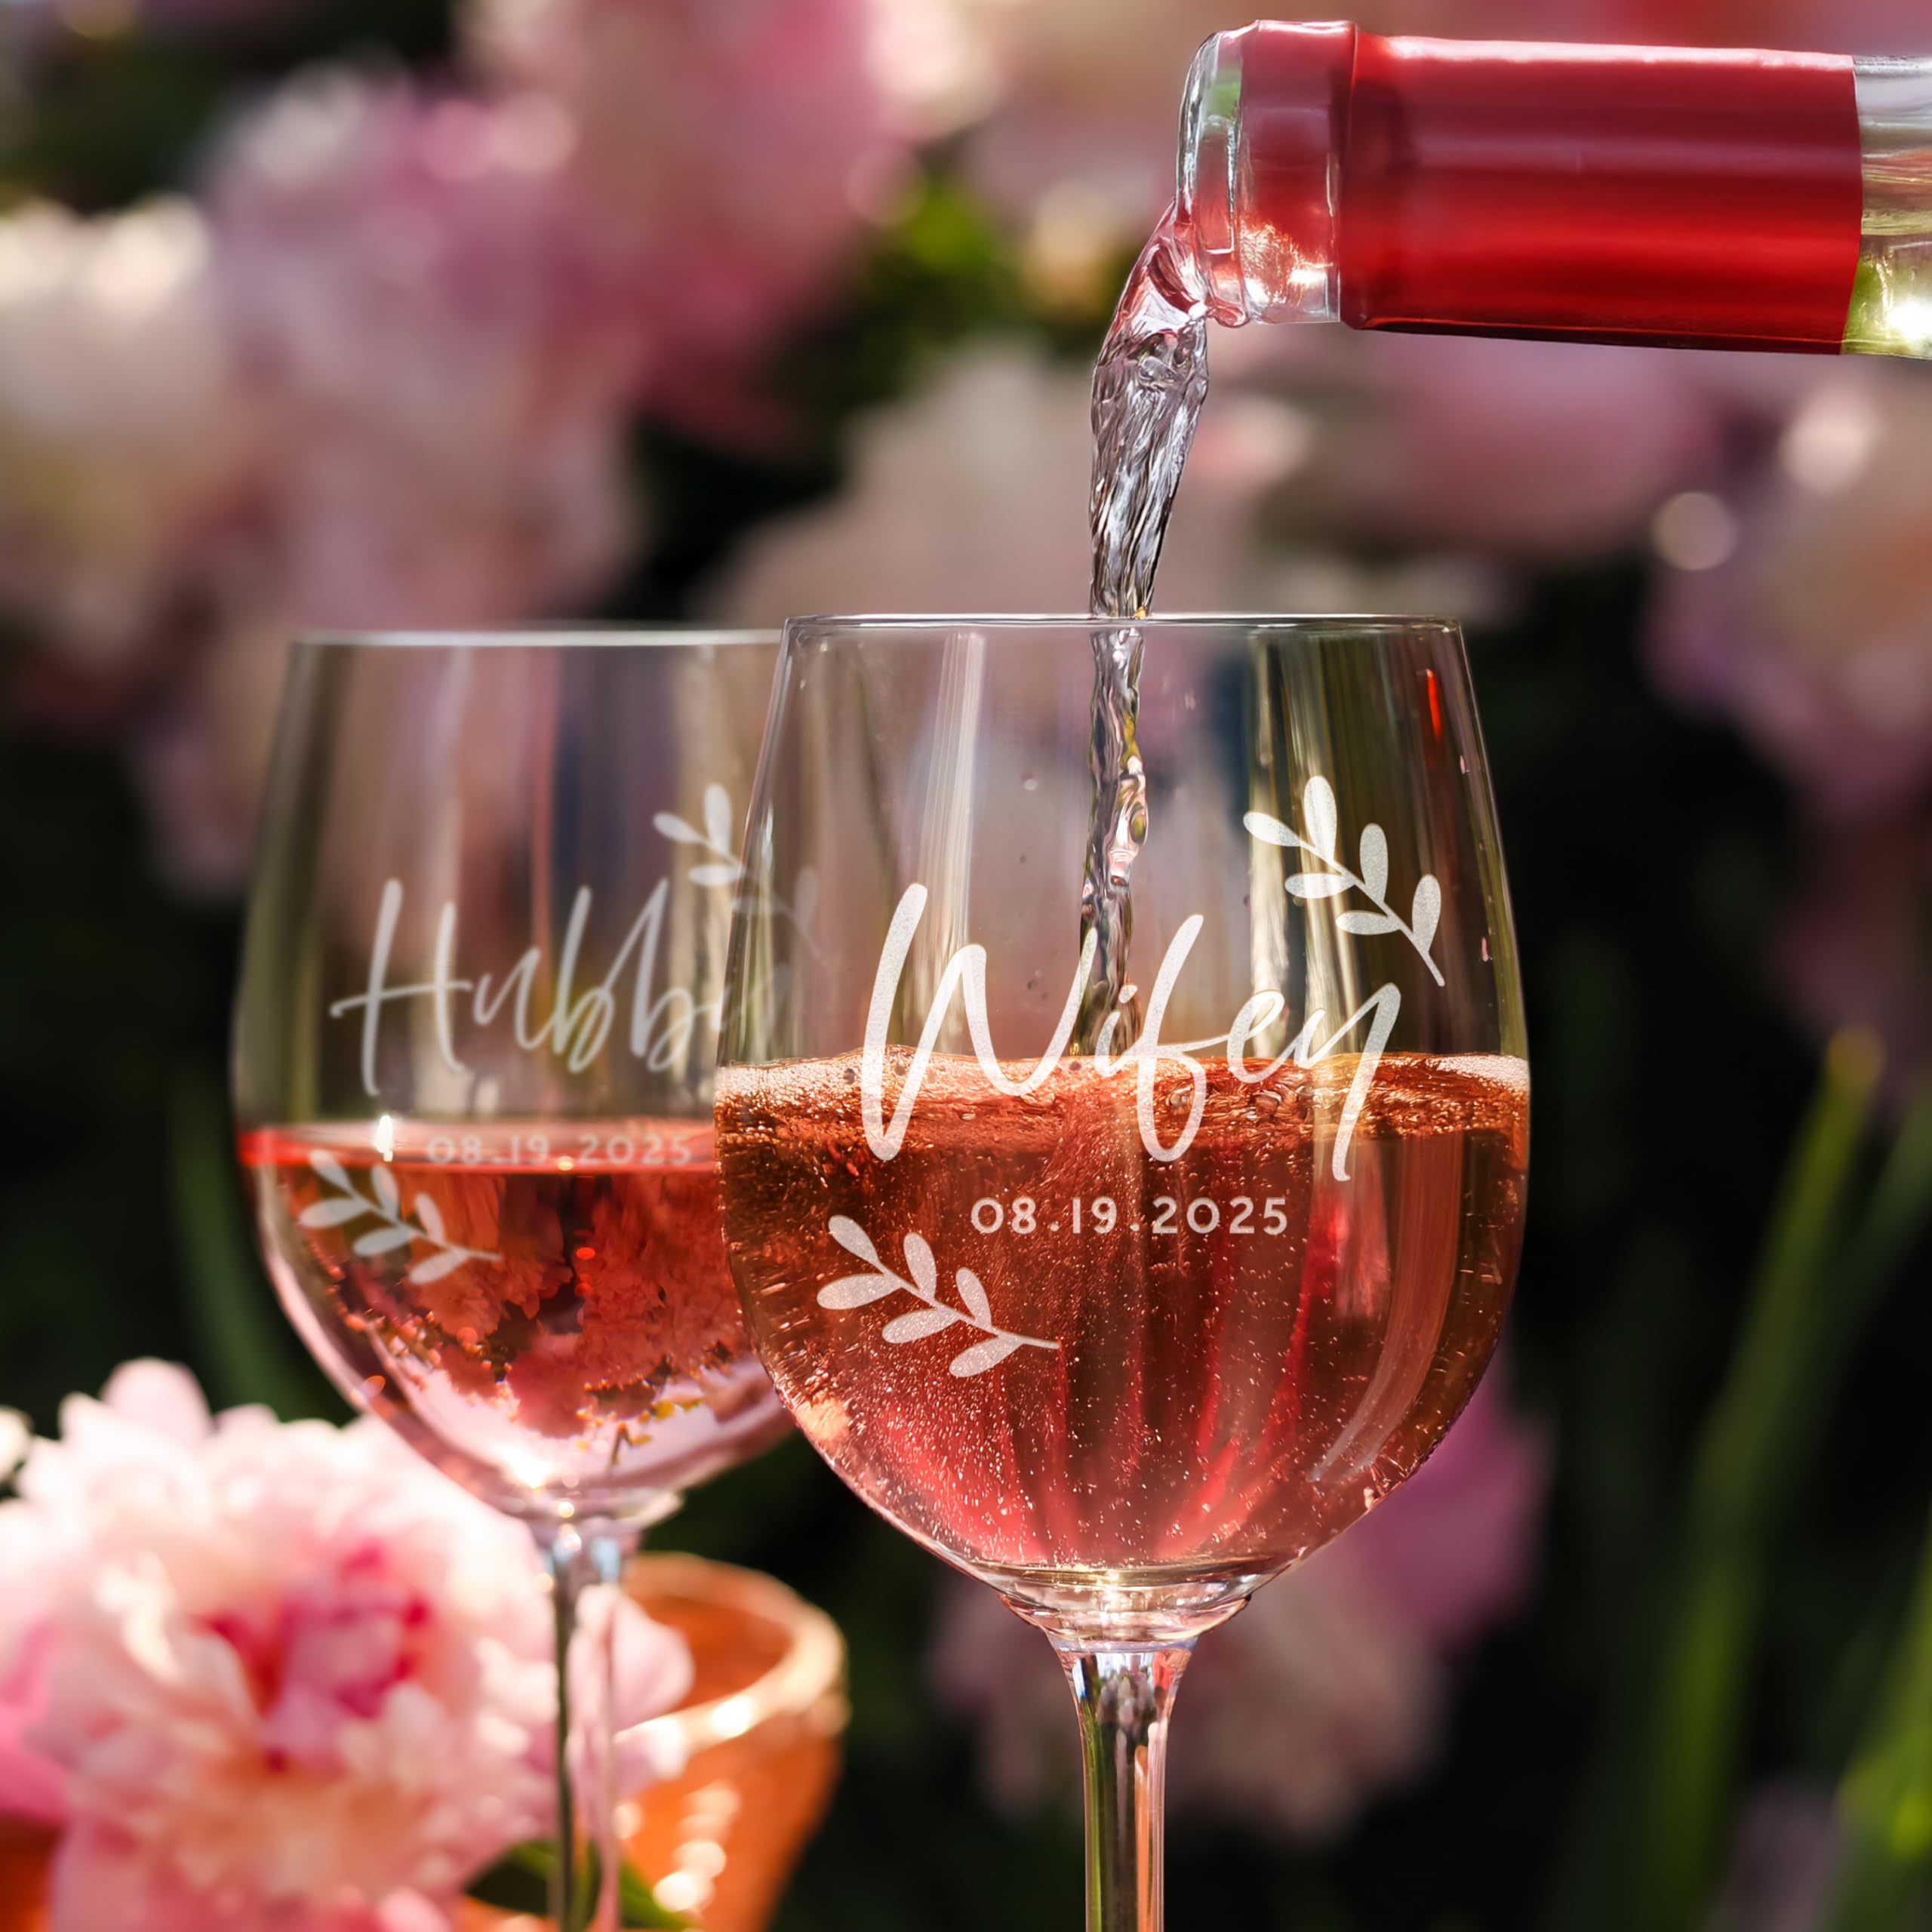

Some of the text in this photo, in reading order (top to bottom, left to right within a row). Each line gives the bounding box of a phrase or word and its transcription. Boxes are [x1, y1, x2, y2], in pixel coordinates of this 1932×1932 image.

[329, 878, 729, 1096] Hubb
[860, 883, 1401, 1181] Wifey
[971, 1197, 1288, 1235] 08.19.2025
